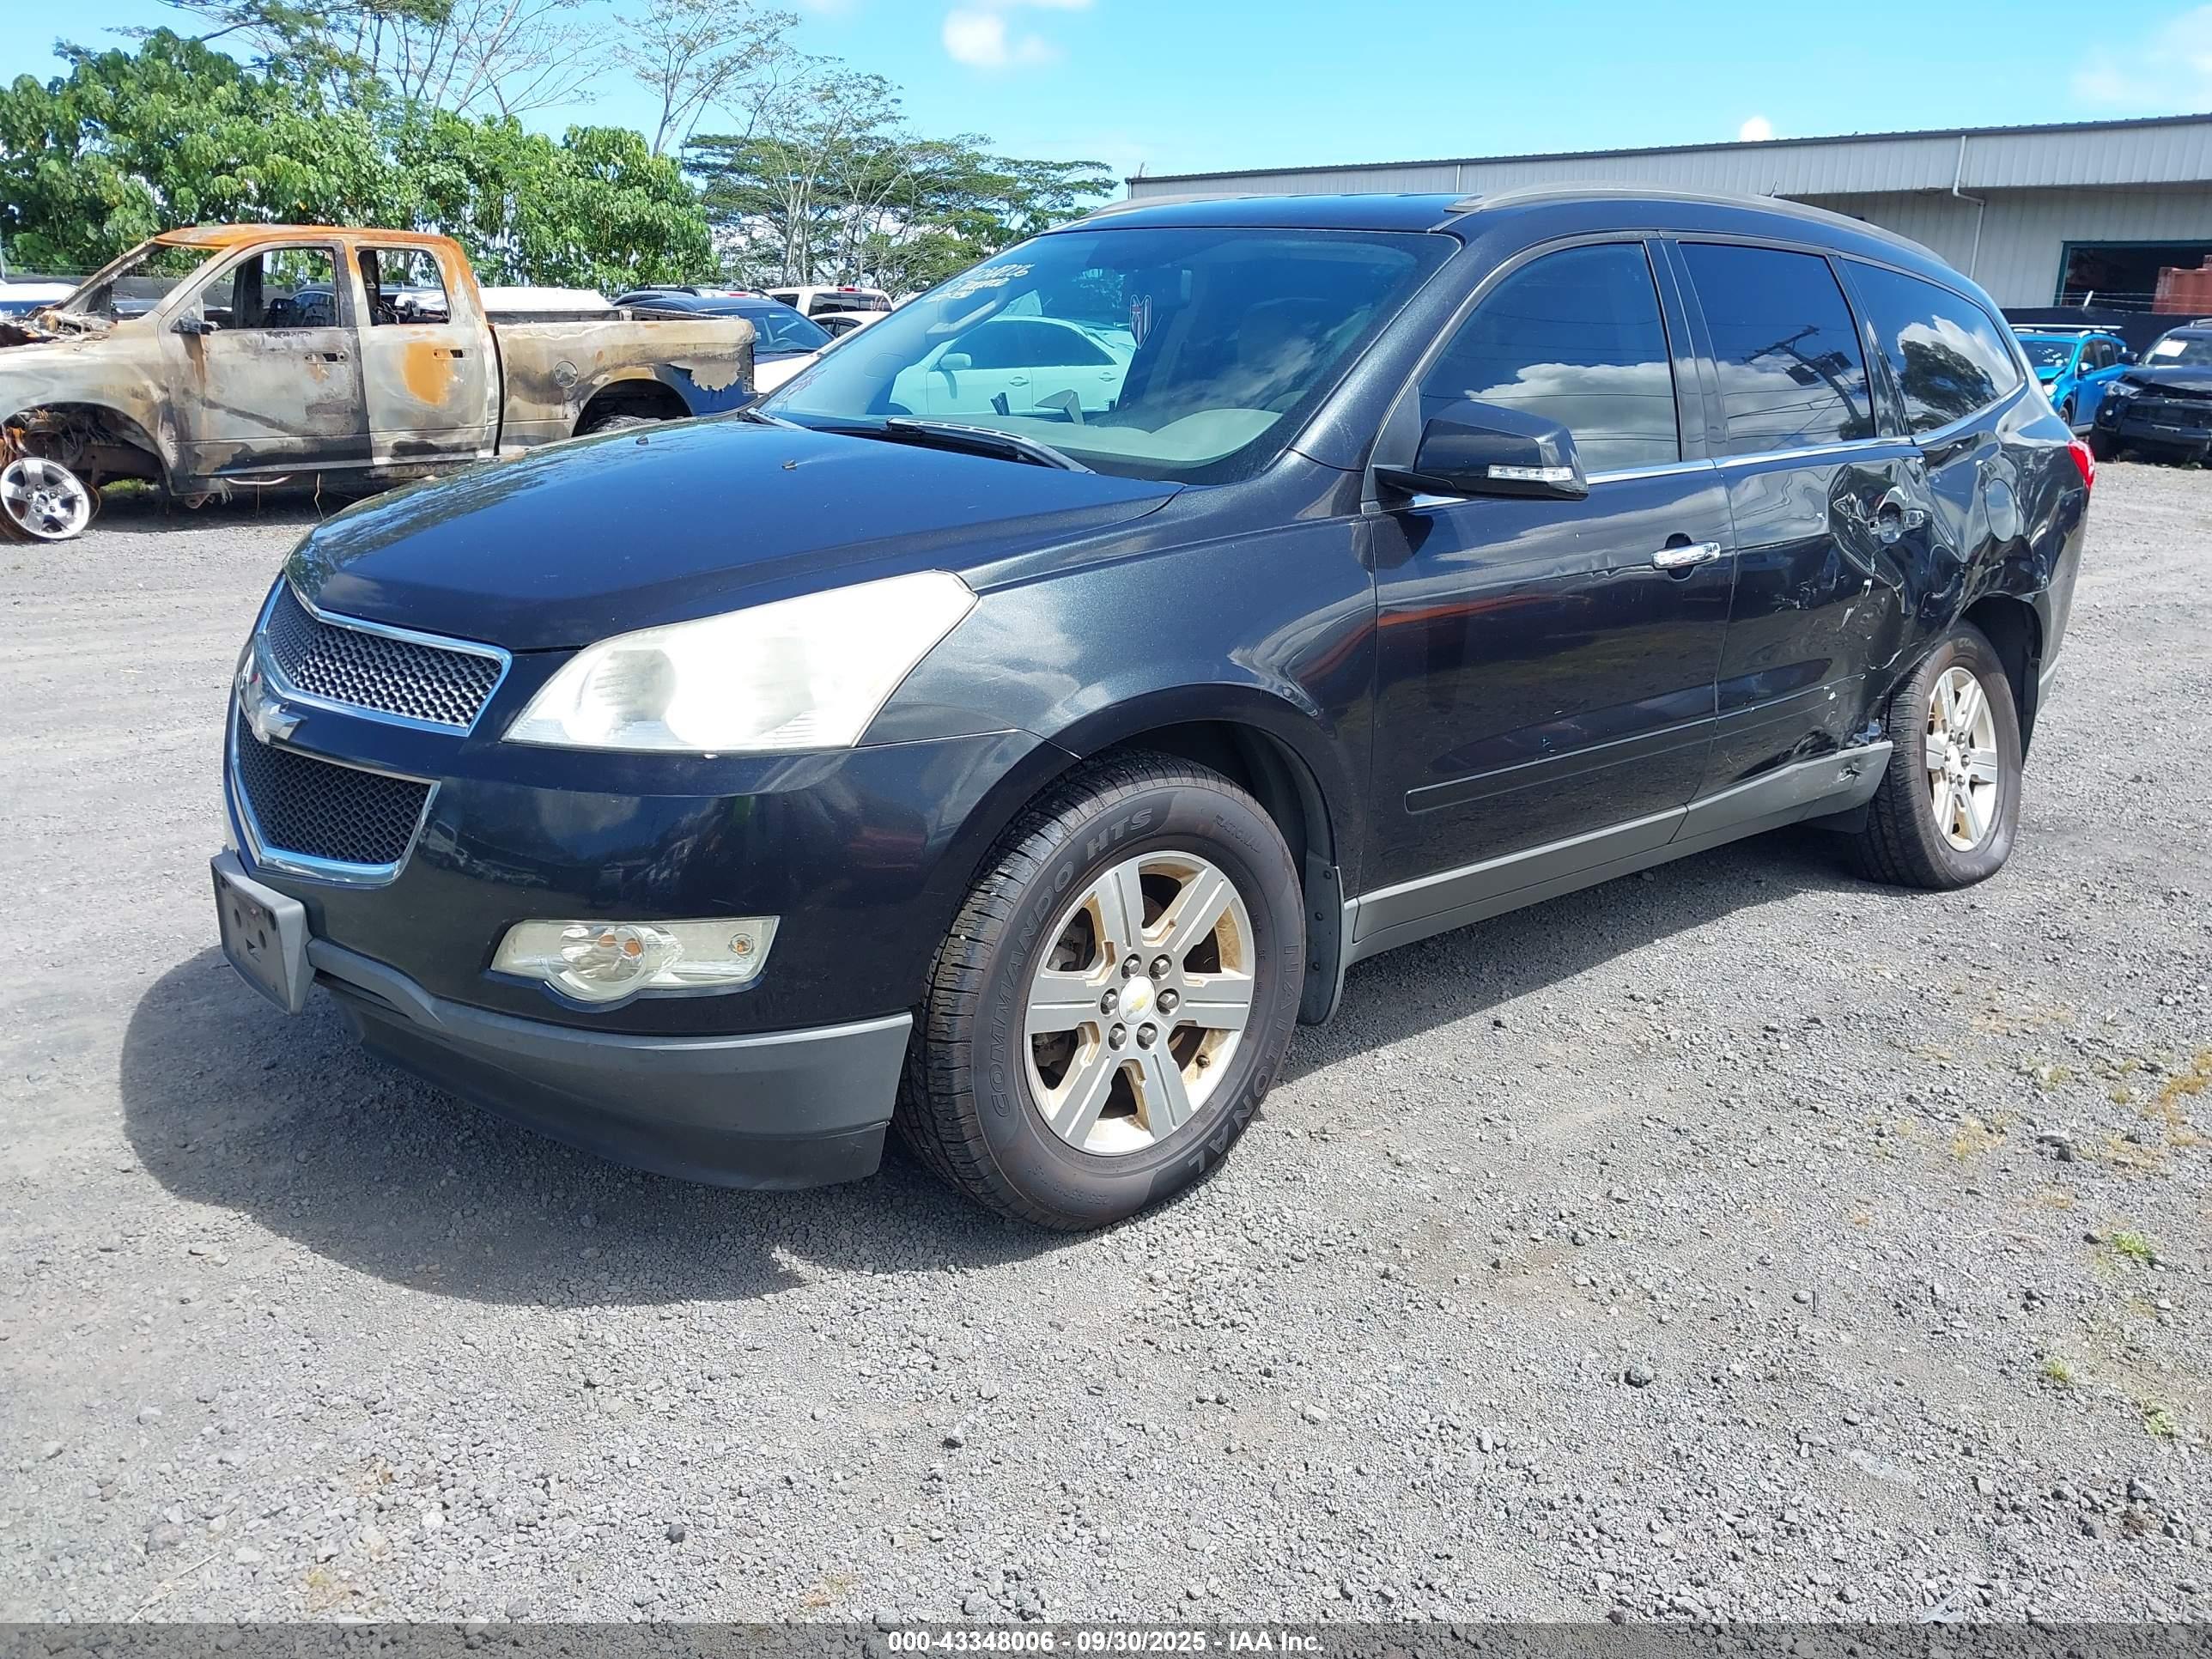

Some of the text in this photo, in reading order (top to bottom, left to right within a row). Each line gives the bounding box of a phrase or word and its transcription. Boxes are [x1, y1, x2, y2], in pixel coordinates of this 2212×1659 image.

[987, 861, 1077, 1119] COMMANDO
[1085, 807, 1153, 861] HTS
[1188, 943, 1298, 1176] NATIONAL
